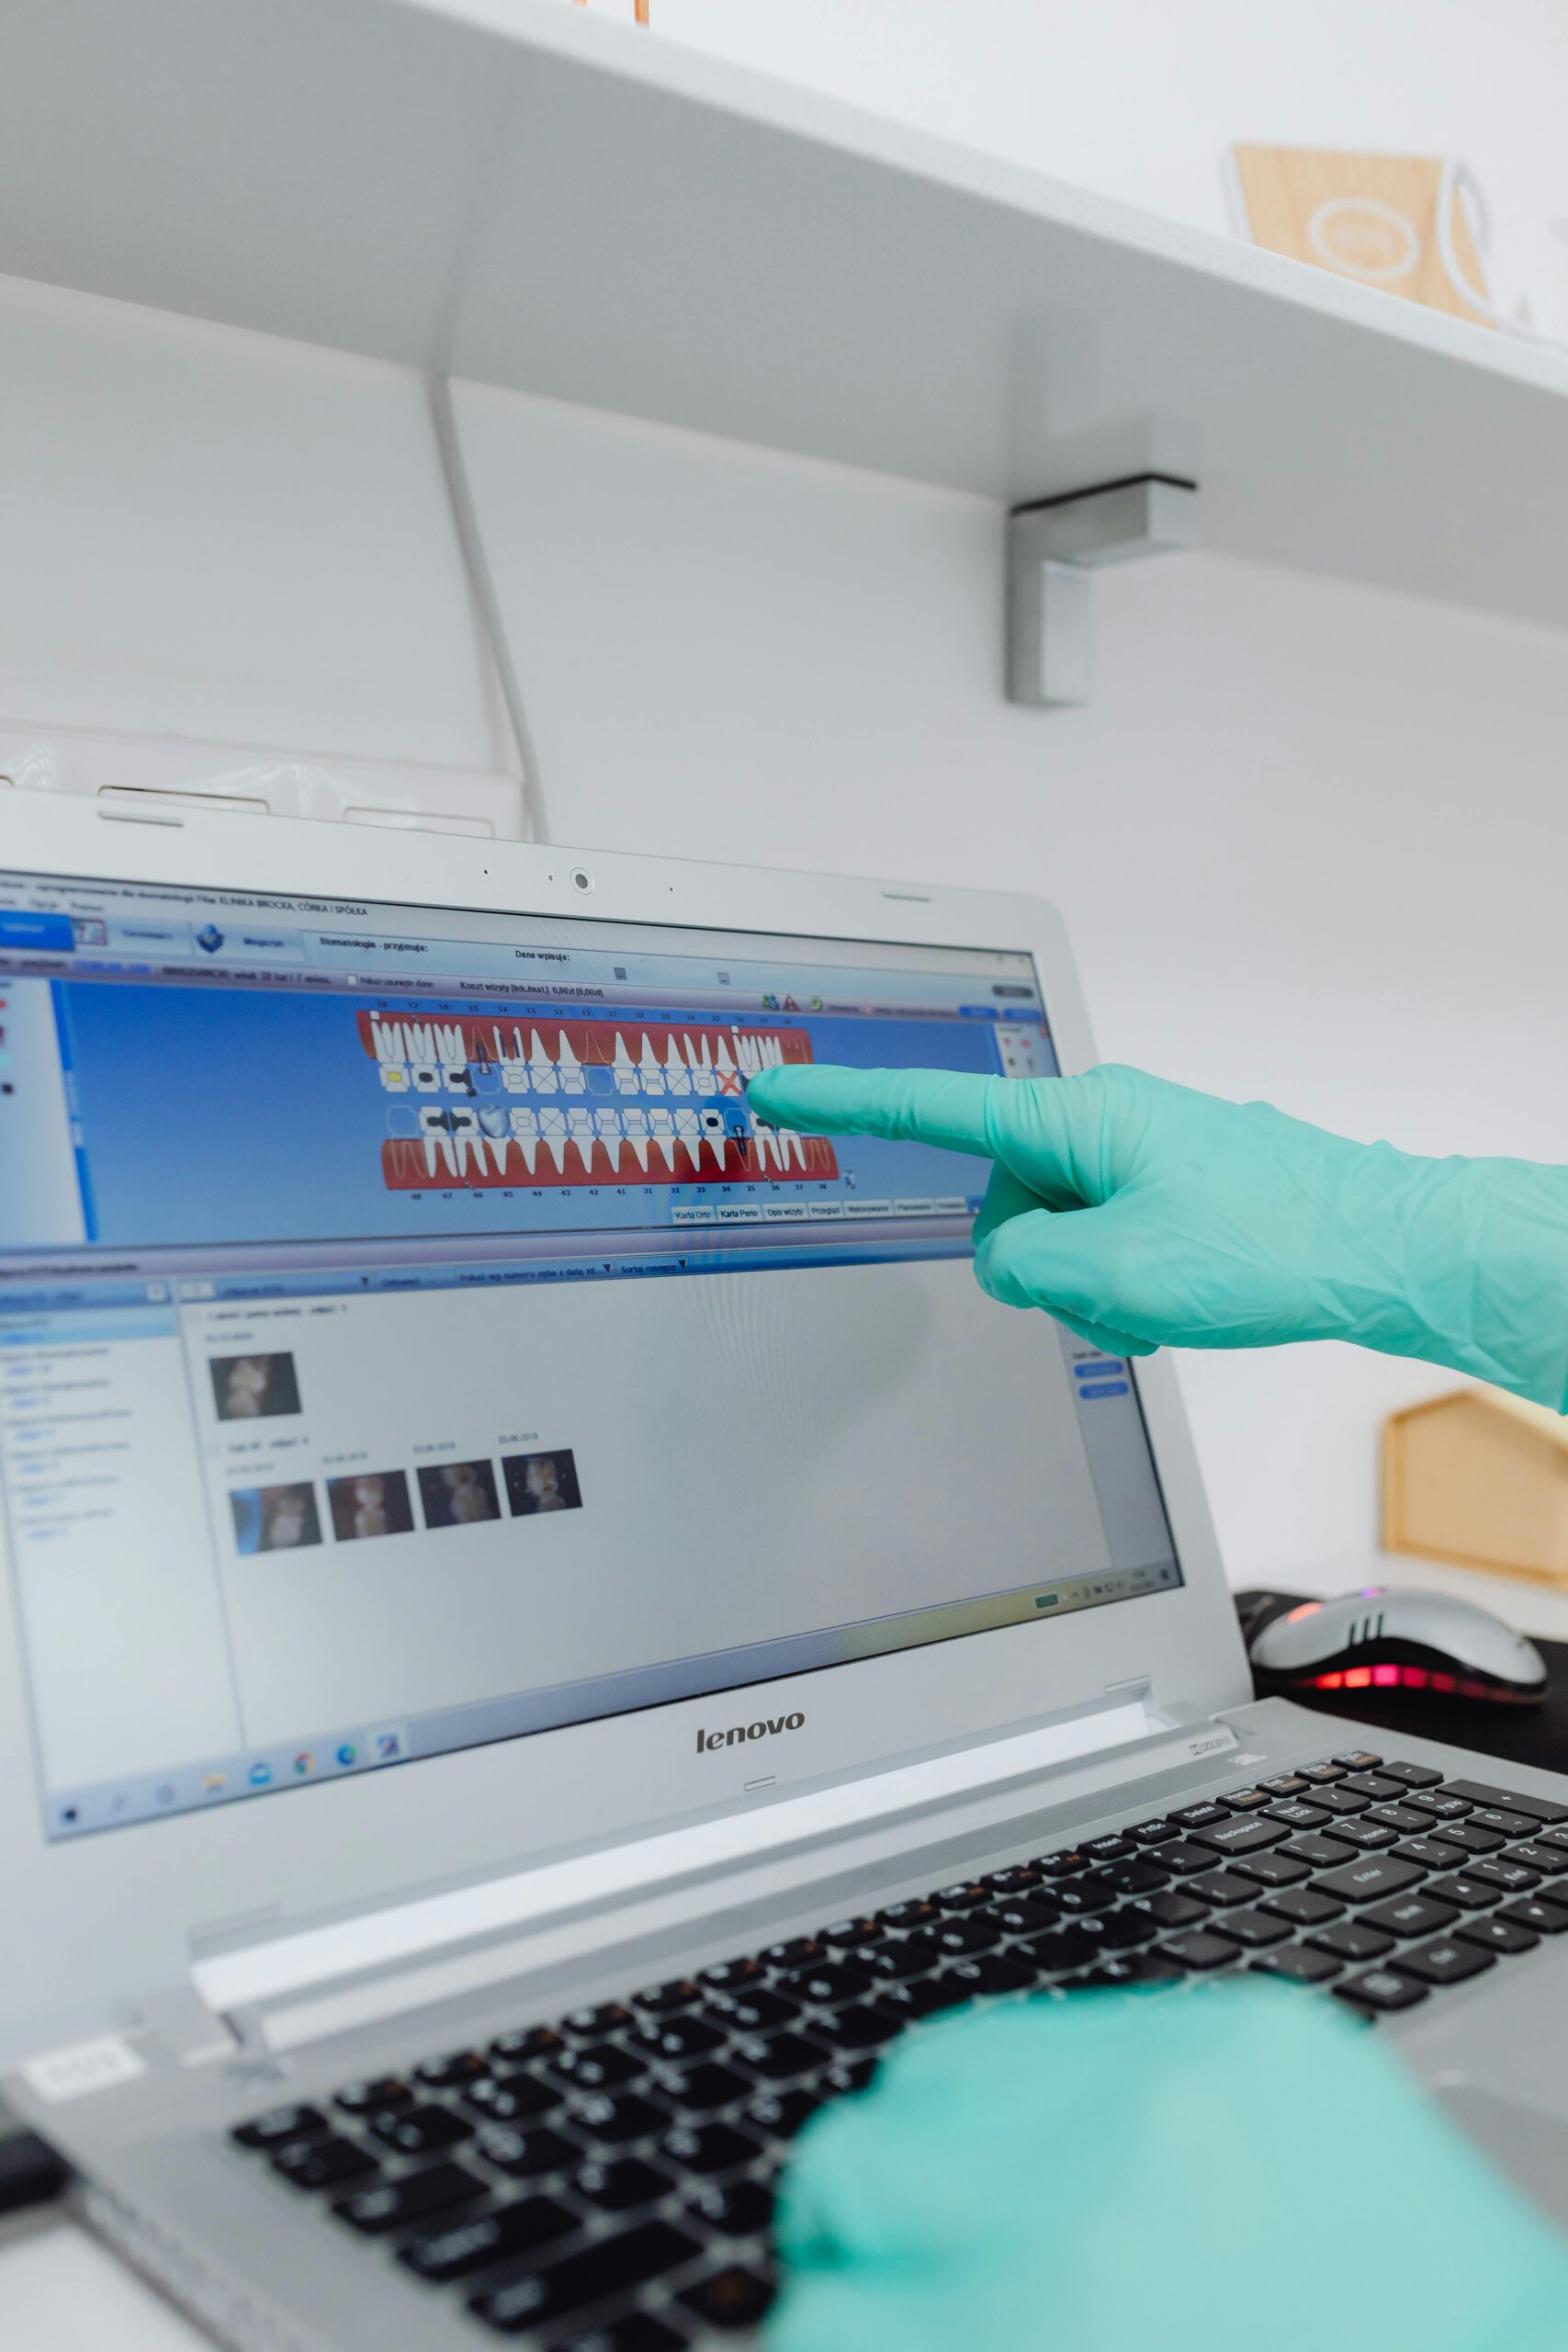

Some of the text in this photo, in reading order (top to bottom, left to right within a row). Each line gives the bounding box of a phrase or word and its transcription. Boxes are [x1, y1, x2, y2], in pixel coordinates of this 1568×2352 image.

[299, 899, 329, 912] CÓRKA
[334, 903, 368, 916] SPÓŁKA
[515, 950, 570, 962] Dane wpisuje:
[460, 981, 484, 990] Koszt
[485, 983, 510, 993] wizyty
[676, 1211, 711, 1220] Karta Orto
[720, 1209, 758, 1218] Karta Perio
[767, 1208, 804, 1217] Opis wizyty
[621, 1265, 644, 1274] Sortuj
[696, 1712, 806, 1754] lenovo
[1183, 1805, 1215, 1818] Delete
[1277, 1805, 1302, 1815] Num
[1288, 1808, 1314, 1819] Lock
[1214, 1820, 1263, 1840] Backspace
[1359, 1827, 1389, 1840] Home
[1411, 1842, 1427, 1850] 4
[1518, 1847, 1538, 1855] 2
